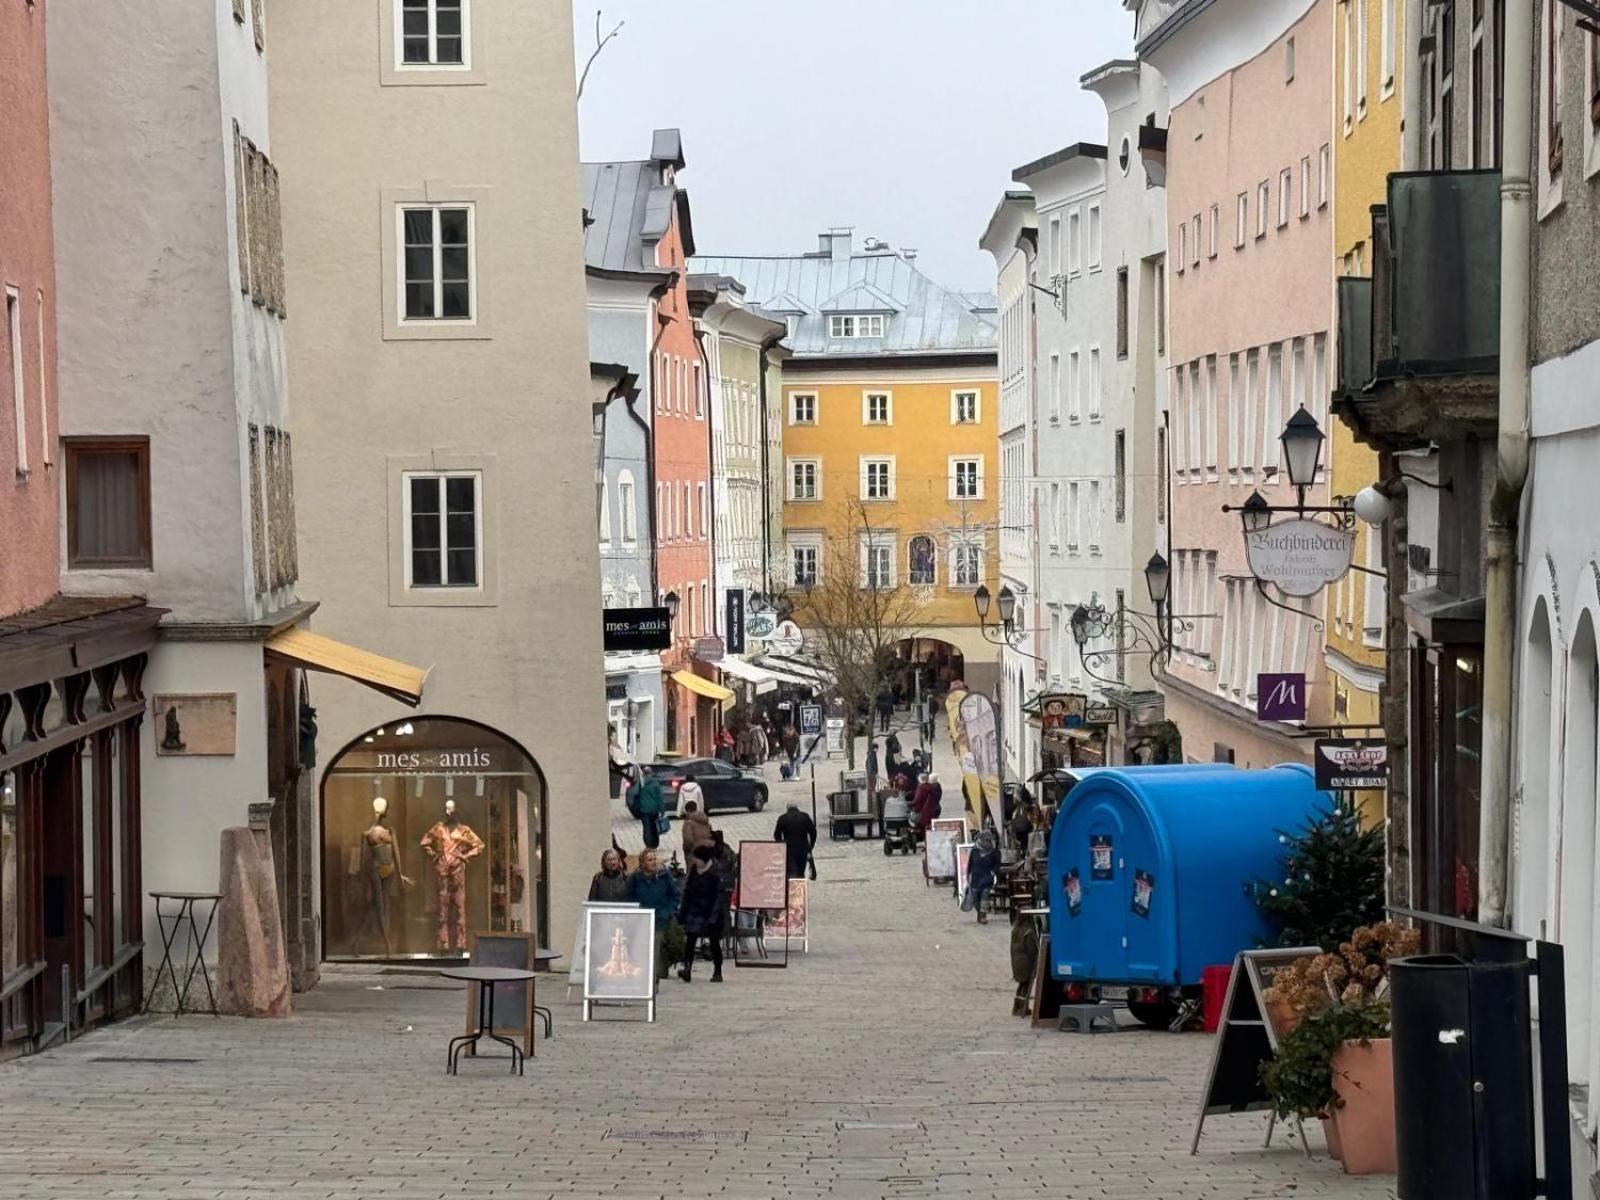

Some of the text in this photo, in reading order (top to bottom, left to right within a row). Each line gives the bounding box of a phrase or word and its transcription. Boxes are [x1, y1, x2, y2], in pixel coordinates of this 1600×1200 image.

[1253, 532, 1347, 553] Buchbinderei
[606, 619, 667, 632] mes amis
[1264, 679, 1297, 711] M
[377, 747, 491, 768] mes amis
[1360, 751, 1382, 761] SHOP
[763, 852, 784, 903] hello
